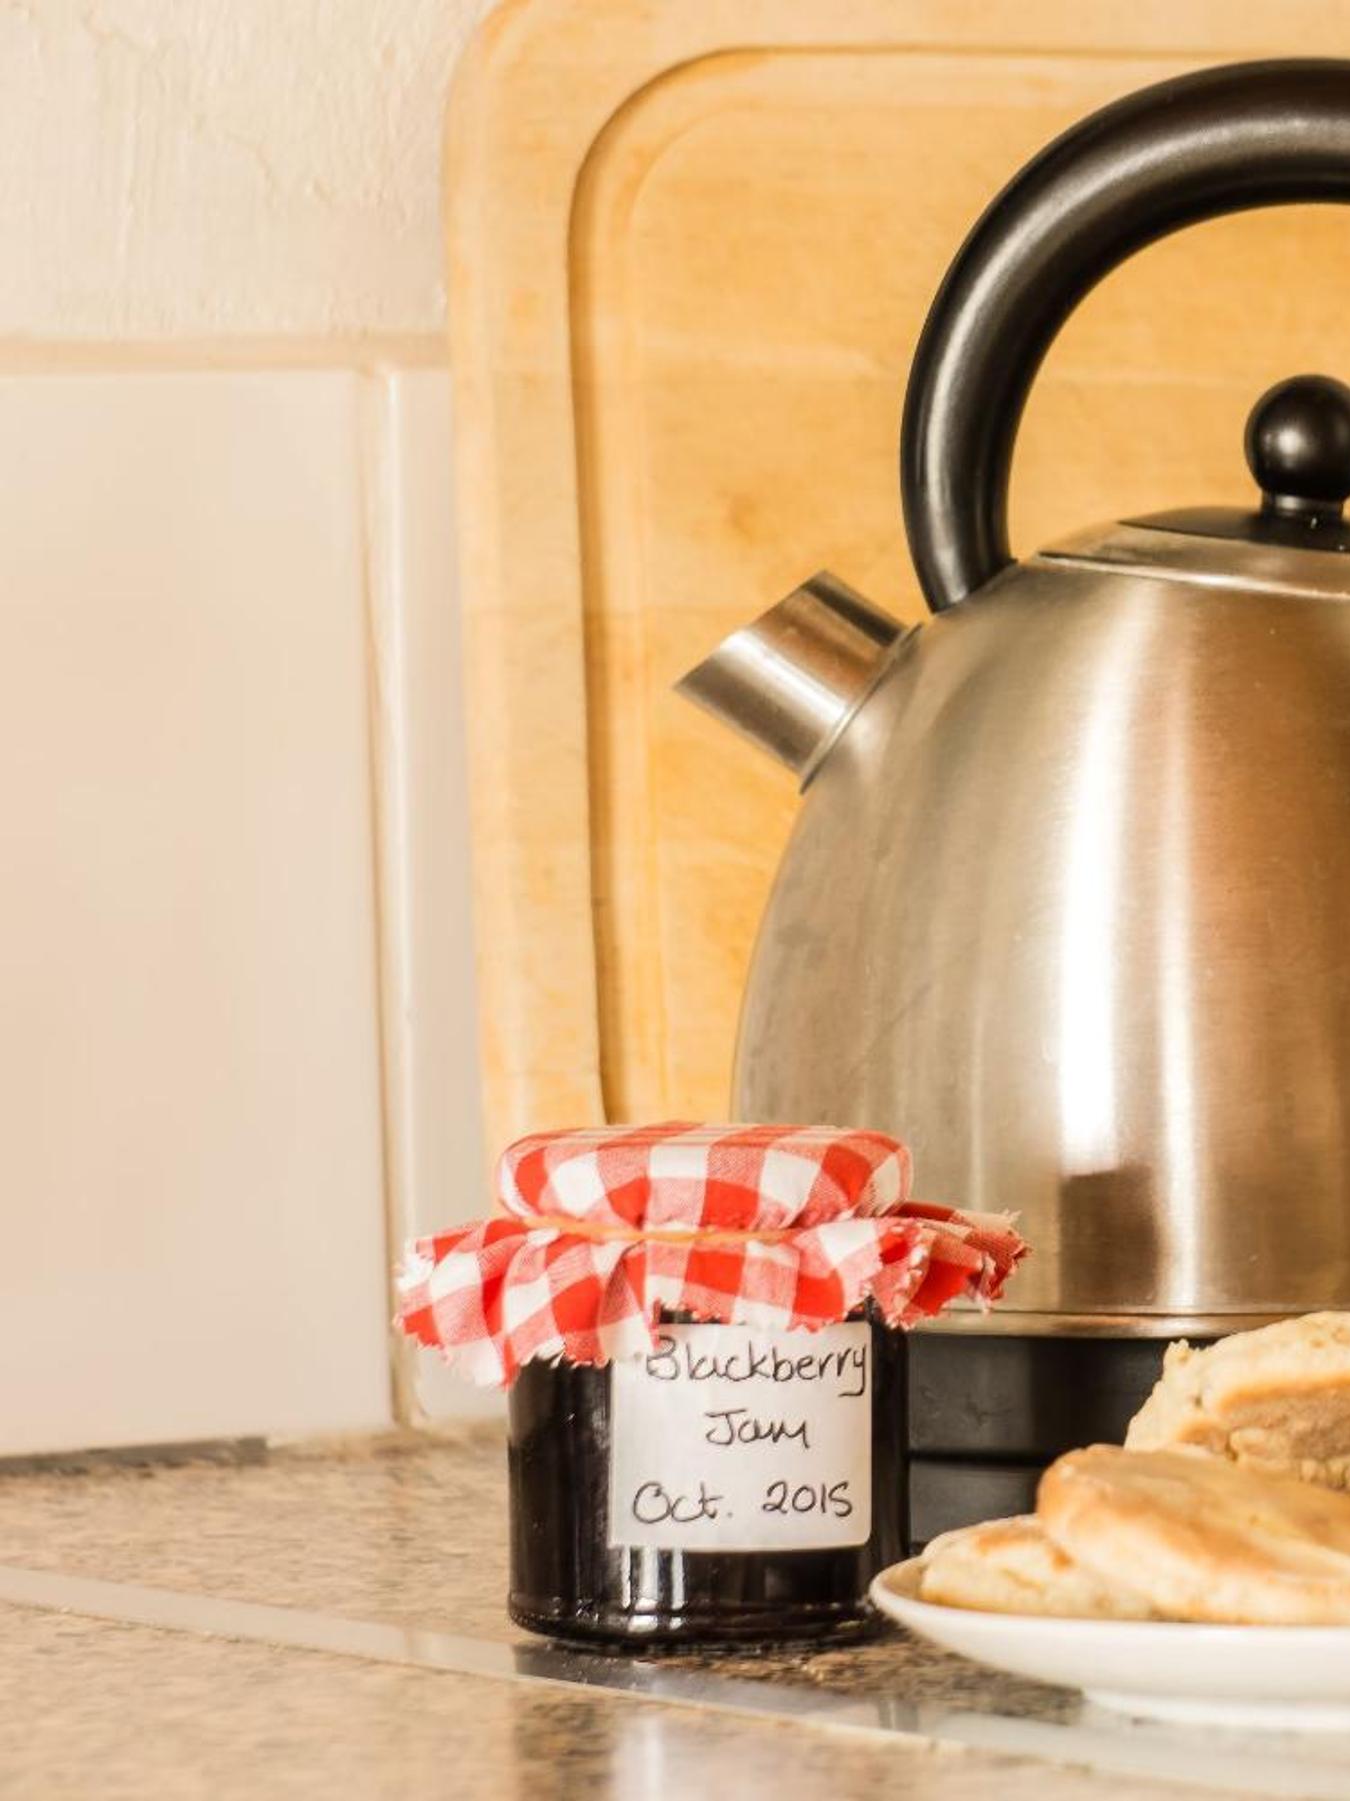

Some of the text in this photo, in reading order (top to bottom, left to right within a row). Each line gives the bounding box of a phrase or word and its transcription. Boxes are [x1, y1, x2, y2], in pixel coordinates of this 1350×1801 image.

[645, 1335, 867, 1398] Blackberry
[705, 1408, 810, 1449] Jam
[632, 1480, 853, 1524] Oct. 2015
